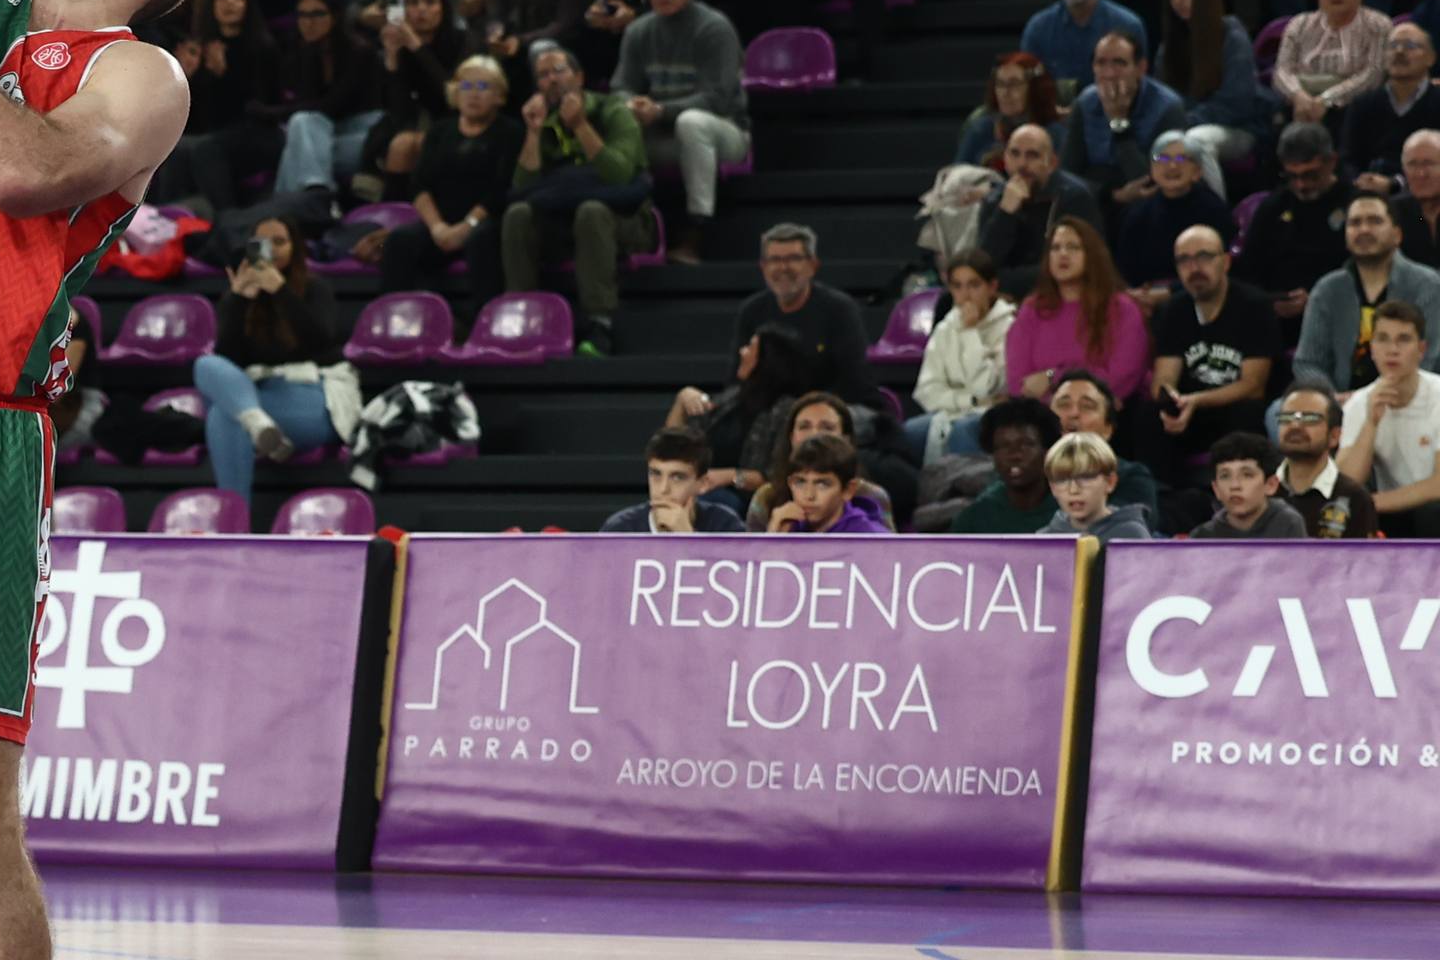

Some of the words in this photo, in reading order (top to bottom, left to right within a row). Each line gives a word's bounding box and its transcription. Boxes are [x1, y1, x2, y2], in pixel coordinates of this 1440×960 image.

[630, 559, 1057, 633] RESIDENCIAL
[726, 660, 938, 732] LOYRA
[469, 714, 531, 732] GRUPO
[404, 736, 593, 762] PARRADO
[1171, 738, 1400, 767] PROMOCIÓN
[616, 757, 737, 788] ARROYO
[747, 760, 783, 790] DE
[793, 762, 825, 791] LA
[835, 763, 1043, 797] ENCOMIENDA
